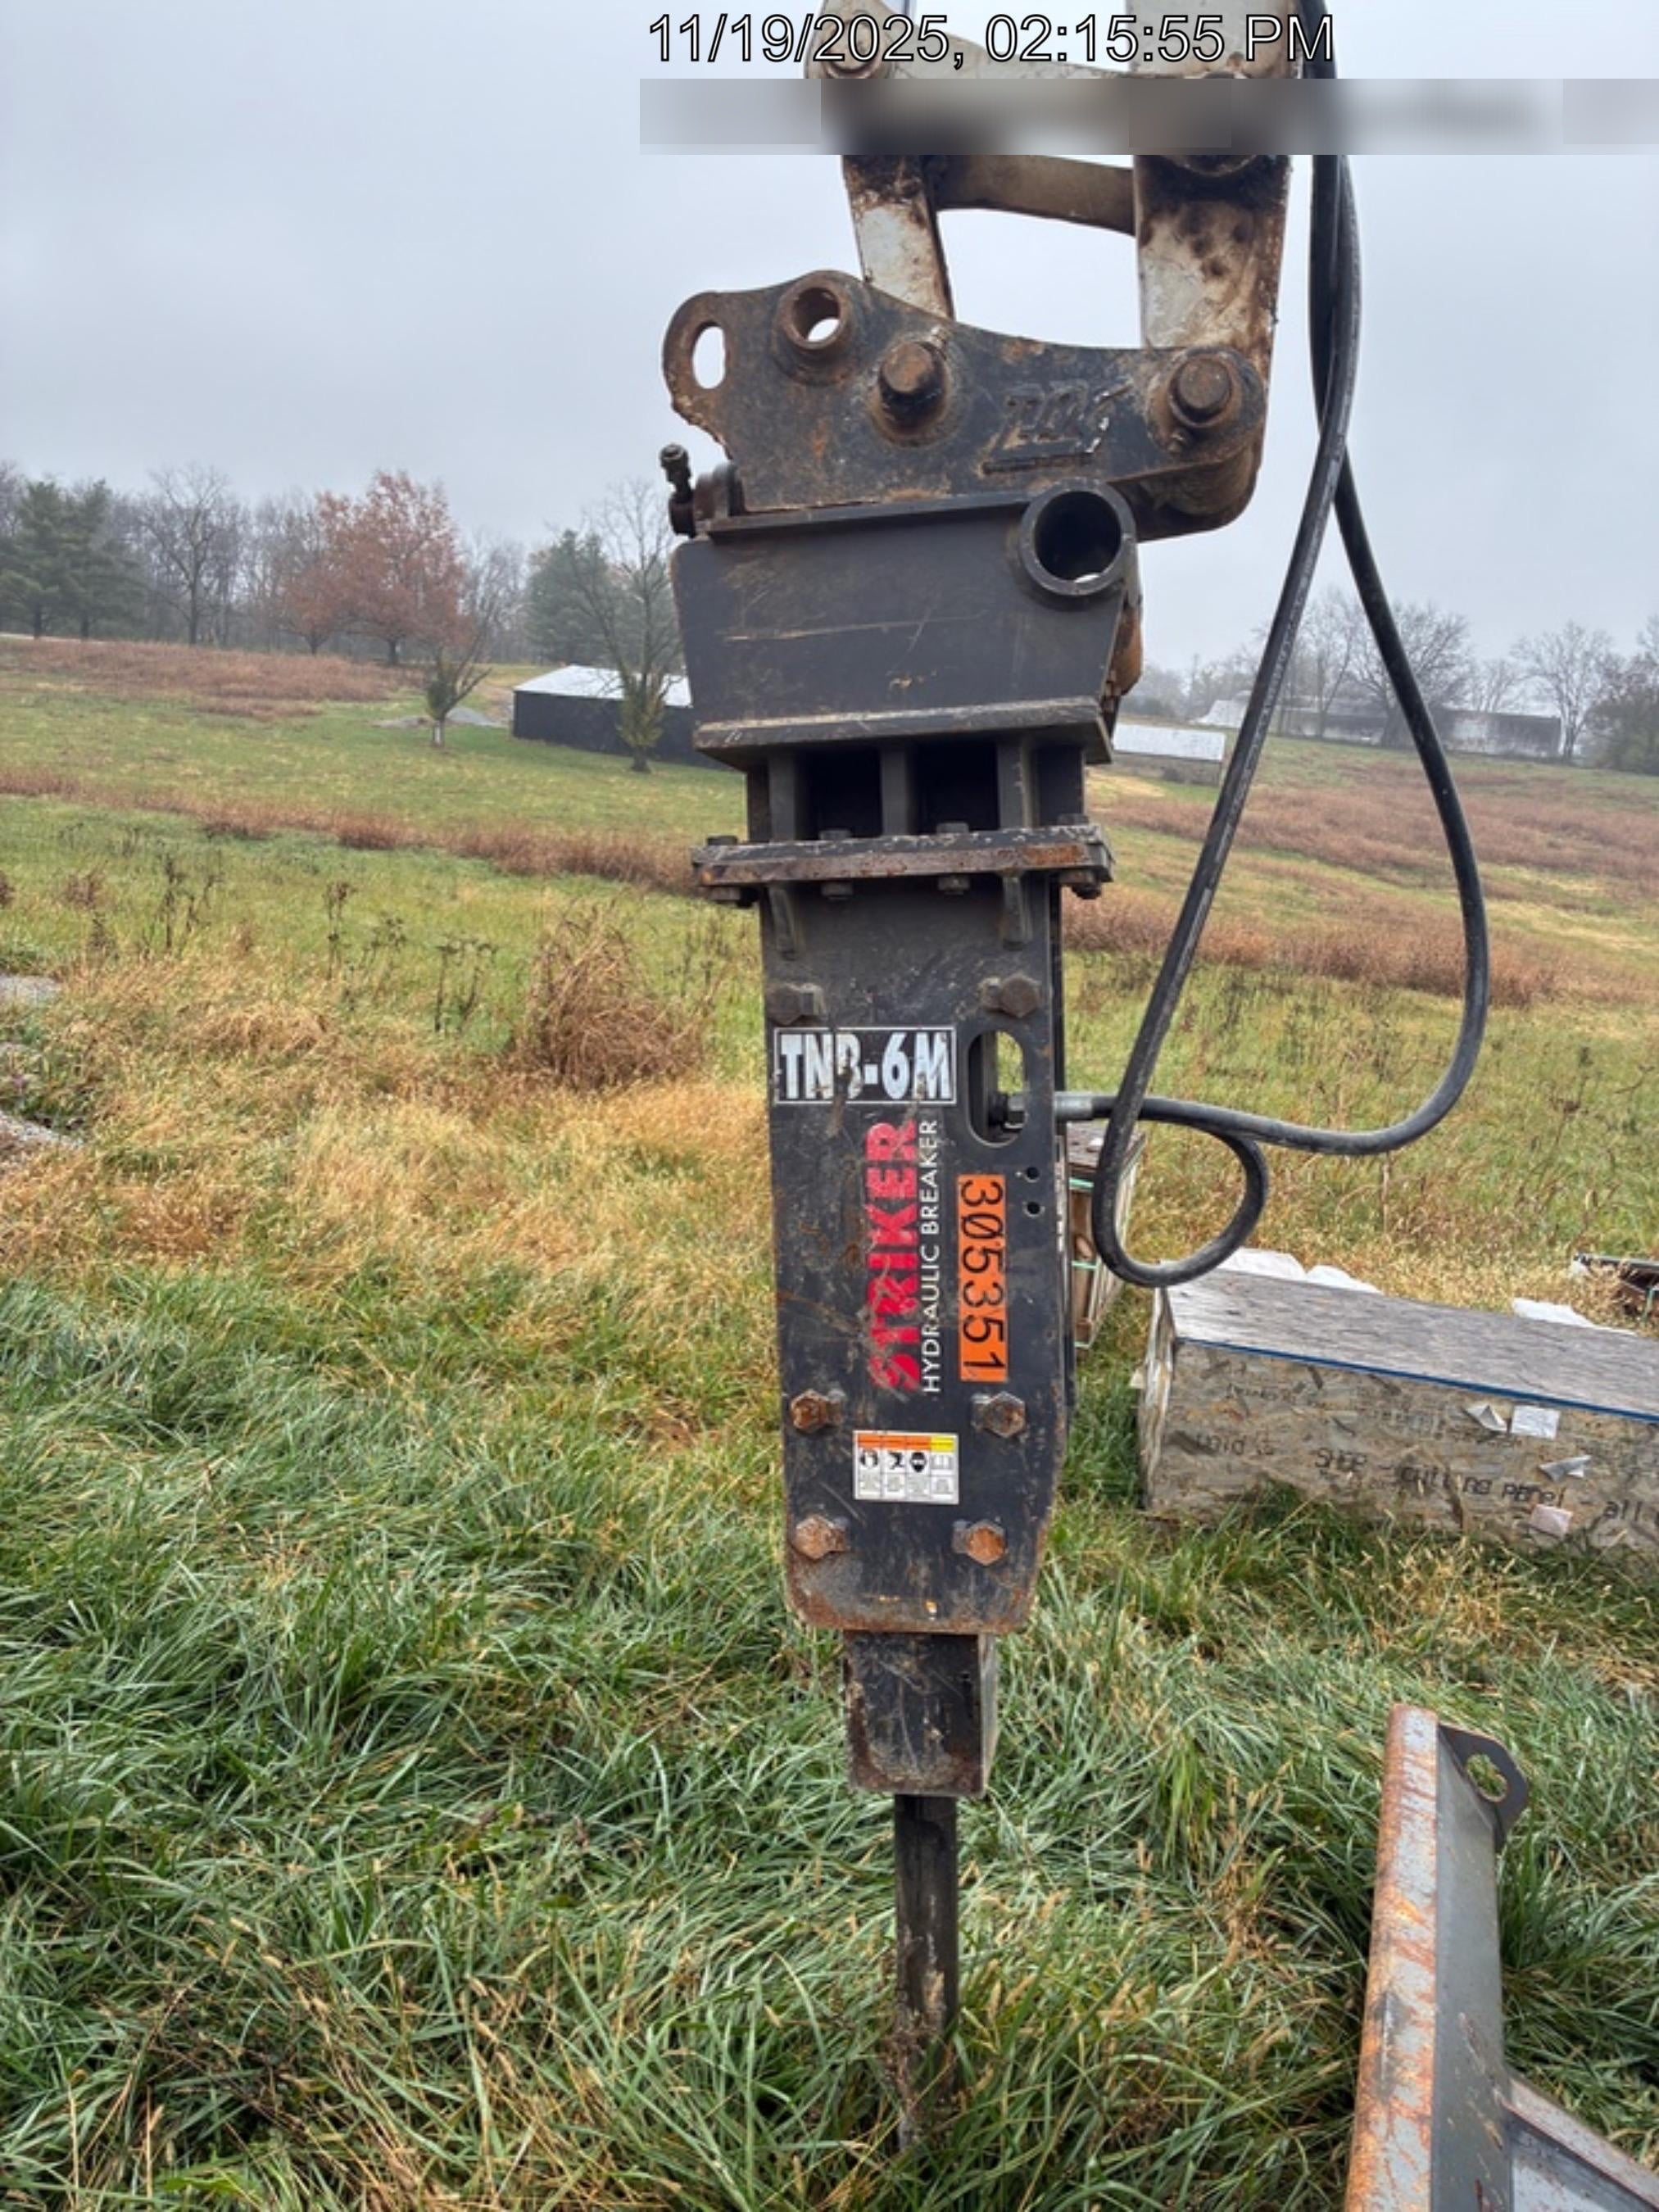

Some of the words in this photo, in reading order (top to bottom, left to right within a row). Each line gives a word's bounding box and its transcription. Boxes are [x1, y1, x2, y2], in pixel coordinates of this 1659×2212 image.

[865, 1119, 921, 1390] STRIKER
[918, 1120, 940, 1235] BREAKER
[920, 1244, 941, 1392] HYDRAULIC
[960, 1180, 1004, 1369] 305351
